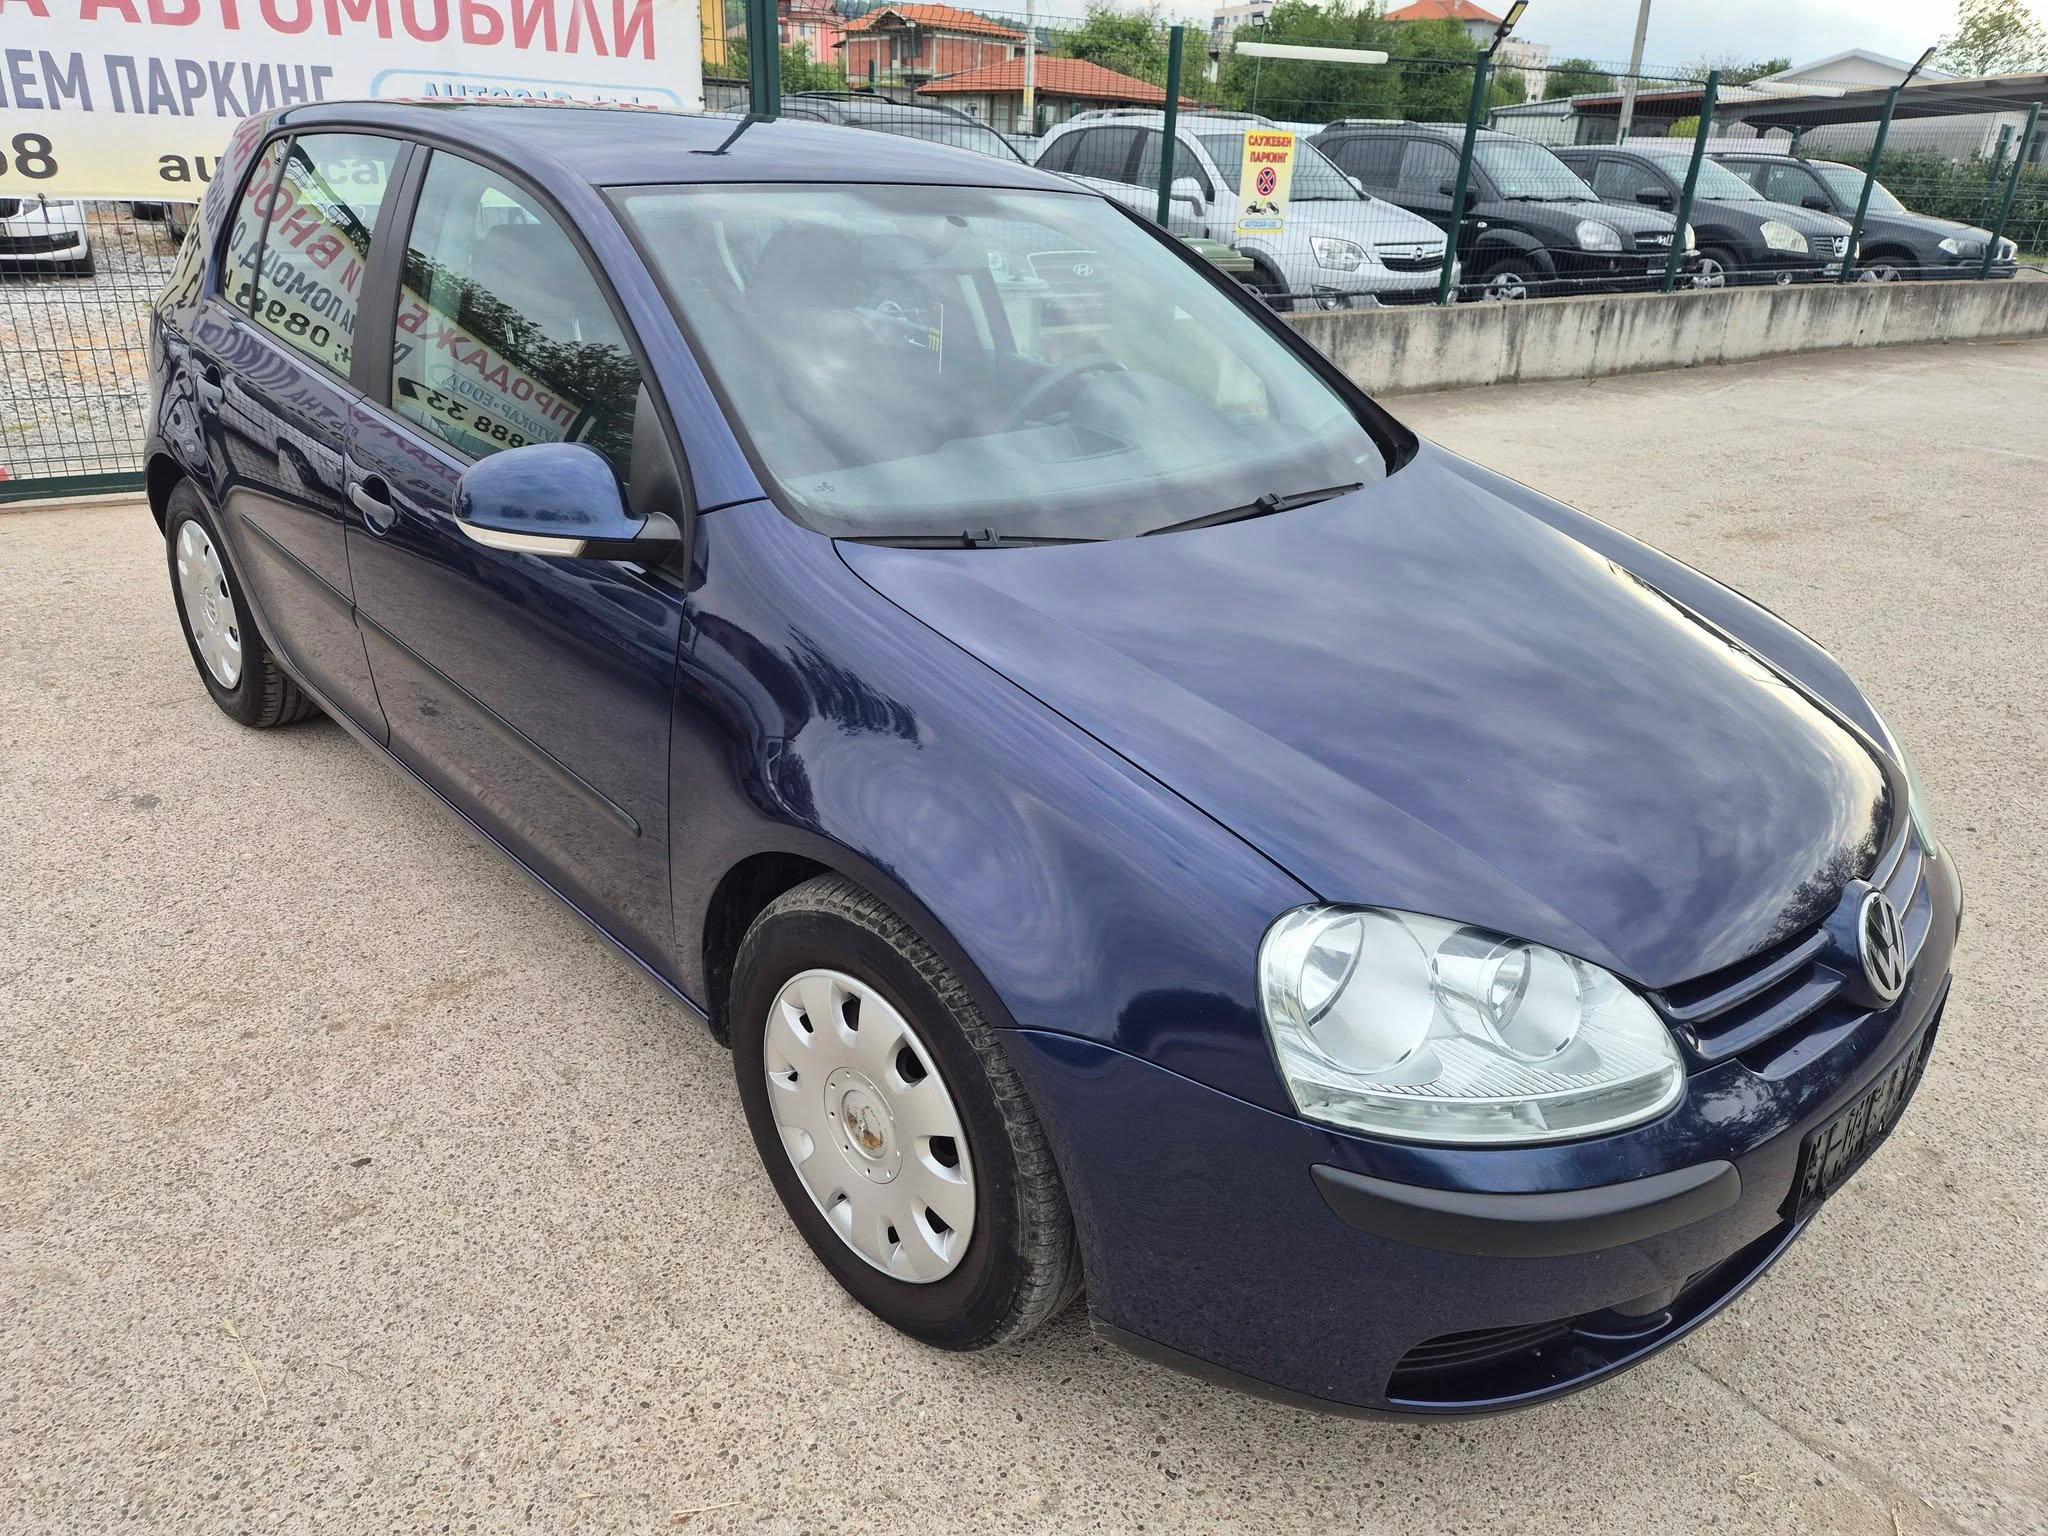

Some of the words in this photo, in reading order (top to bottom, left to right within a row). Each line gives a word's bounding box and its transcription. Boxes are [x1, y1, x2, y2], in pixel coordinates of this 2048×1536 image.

[0, 48, 93, 112] ЕМ
[104, 54, 333, 118] ПАРКИНГ
[1248, 134, 1292, 148] СЛУЖЕБЕН
[0, 133, 58, 180] 8
[1250, 151, 1288, 163] ПАРКИНГ
